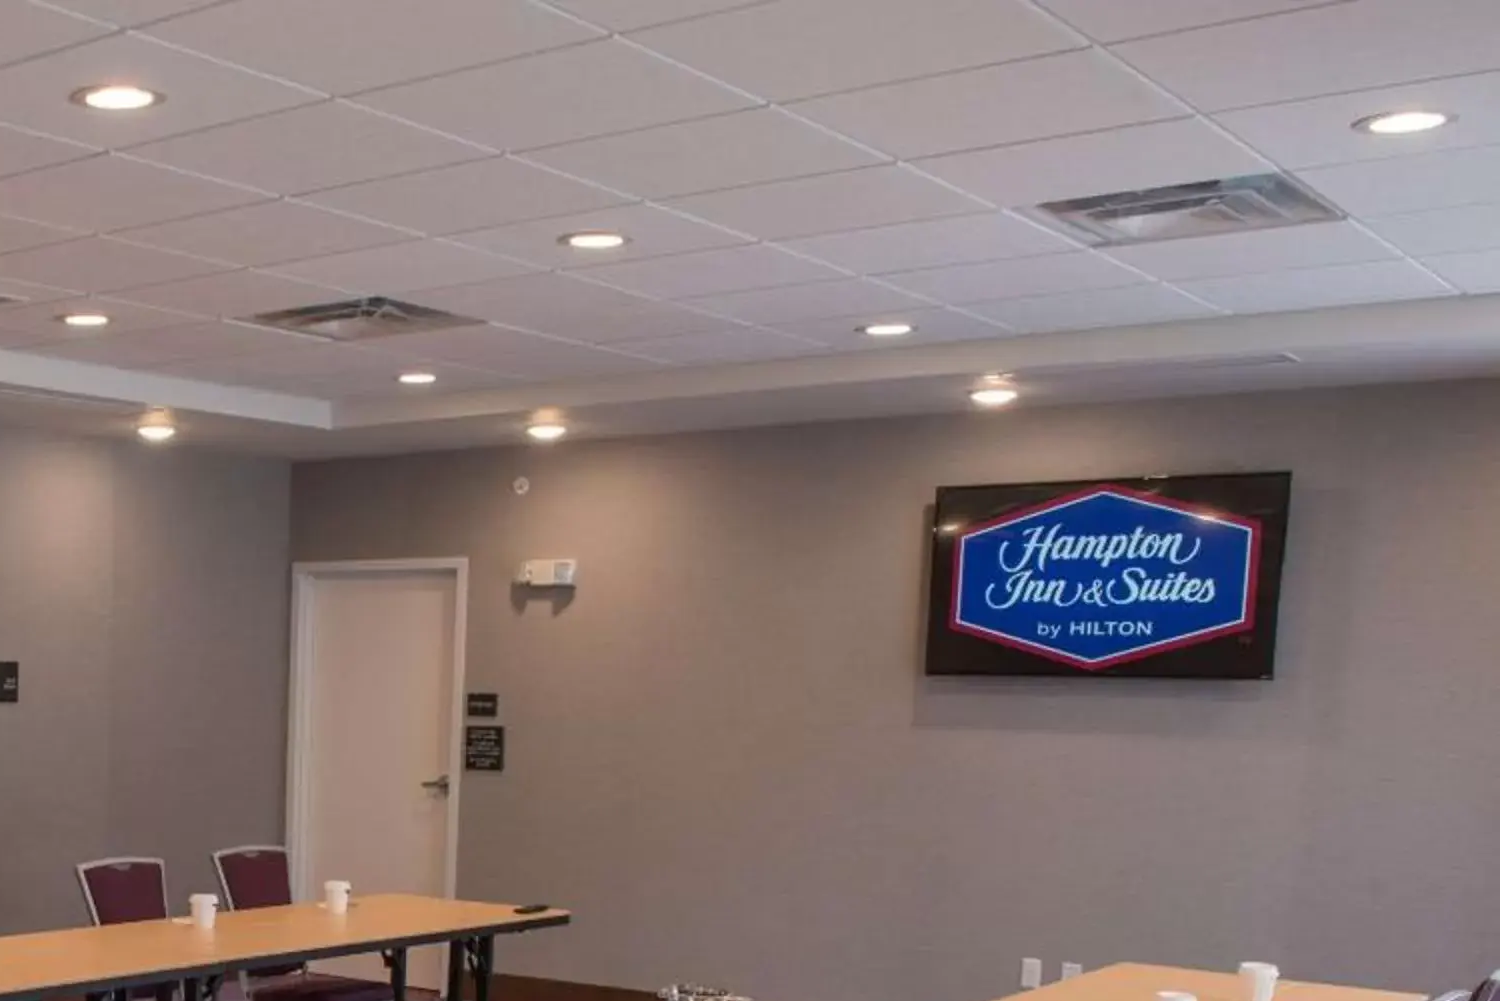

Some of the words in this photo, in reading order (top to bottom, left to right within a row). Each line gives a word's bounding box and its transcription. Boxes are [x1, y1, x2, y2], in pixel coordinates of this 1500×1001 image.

[999, 522, 1201, 573] Hampton
[985, 570, 1083, 610] Inn
[1082, 579, 1109, 608] &
[1106, 567, 1216, 605] Suites
[1036, 622, 1061, 639] by
[1069, 621, 1153, 636] HILTON
